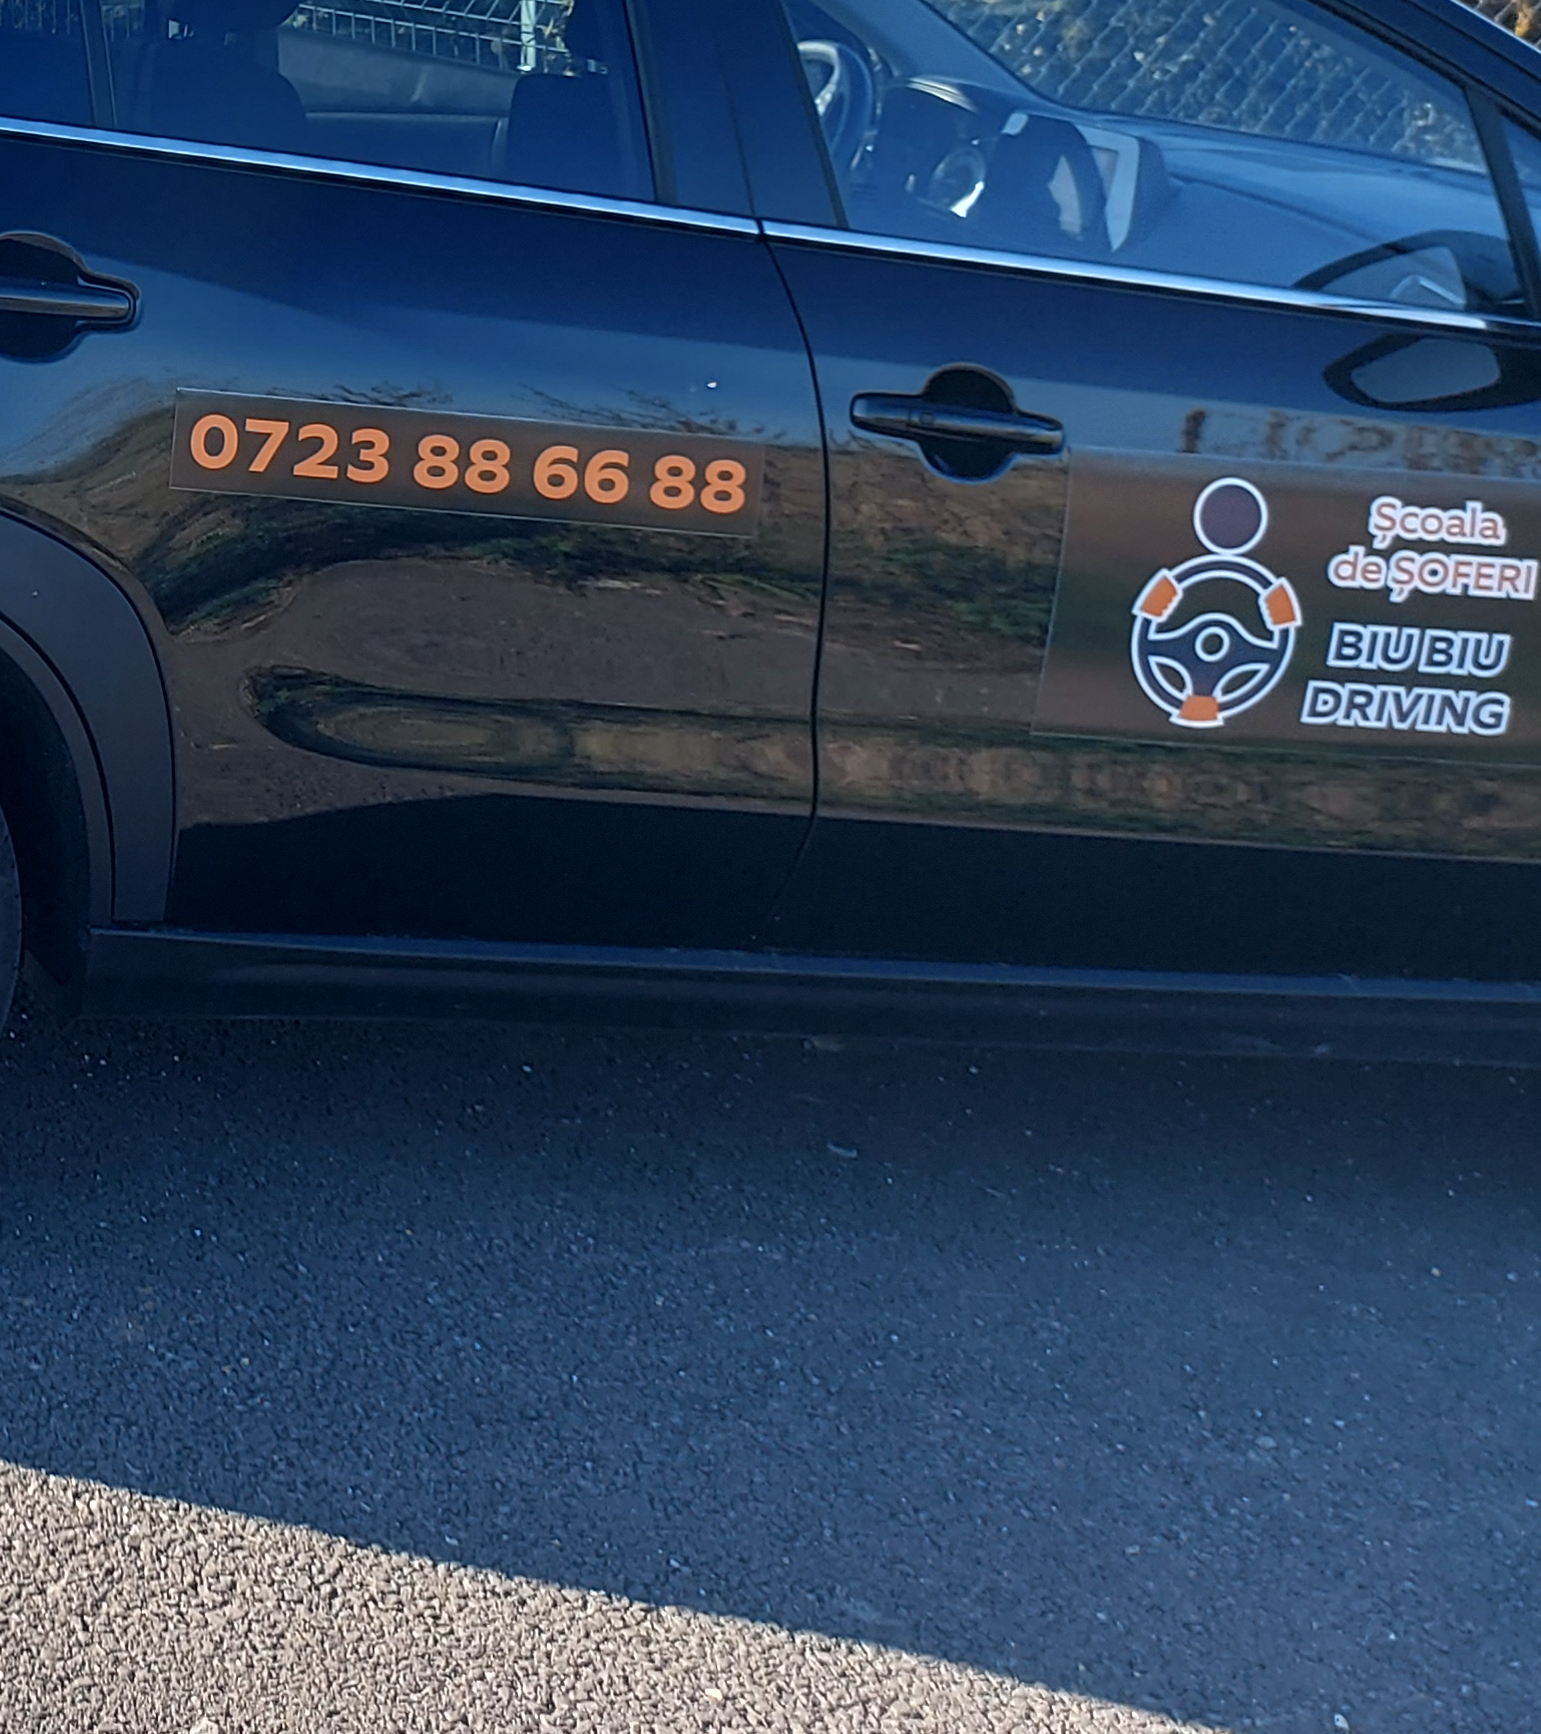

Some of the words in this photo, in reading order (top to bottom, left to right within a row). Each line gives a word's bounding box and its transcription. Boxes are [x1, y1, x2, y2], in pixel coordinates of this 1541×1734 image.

[189, 413, 391, 484] 0723
[412, 433, 511, 495] 88
[531, 444, 631, 505] 66
[648, 454, 747, 515] 88
[1370, 497, 1506, 549] Școala
[1328, 546, 1386, 589] de
[1386, 551, 1539, 603] ȘOFERI
[1300, 679, 1511, 736] DRIVING
